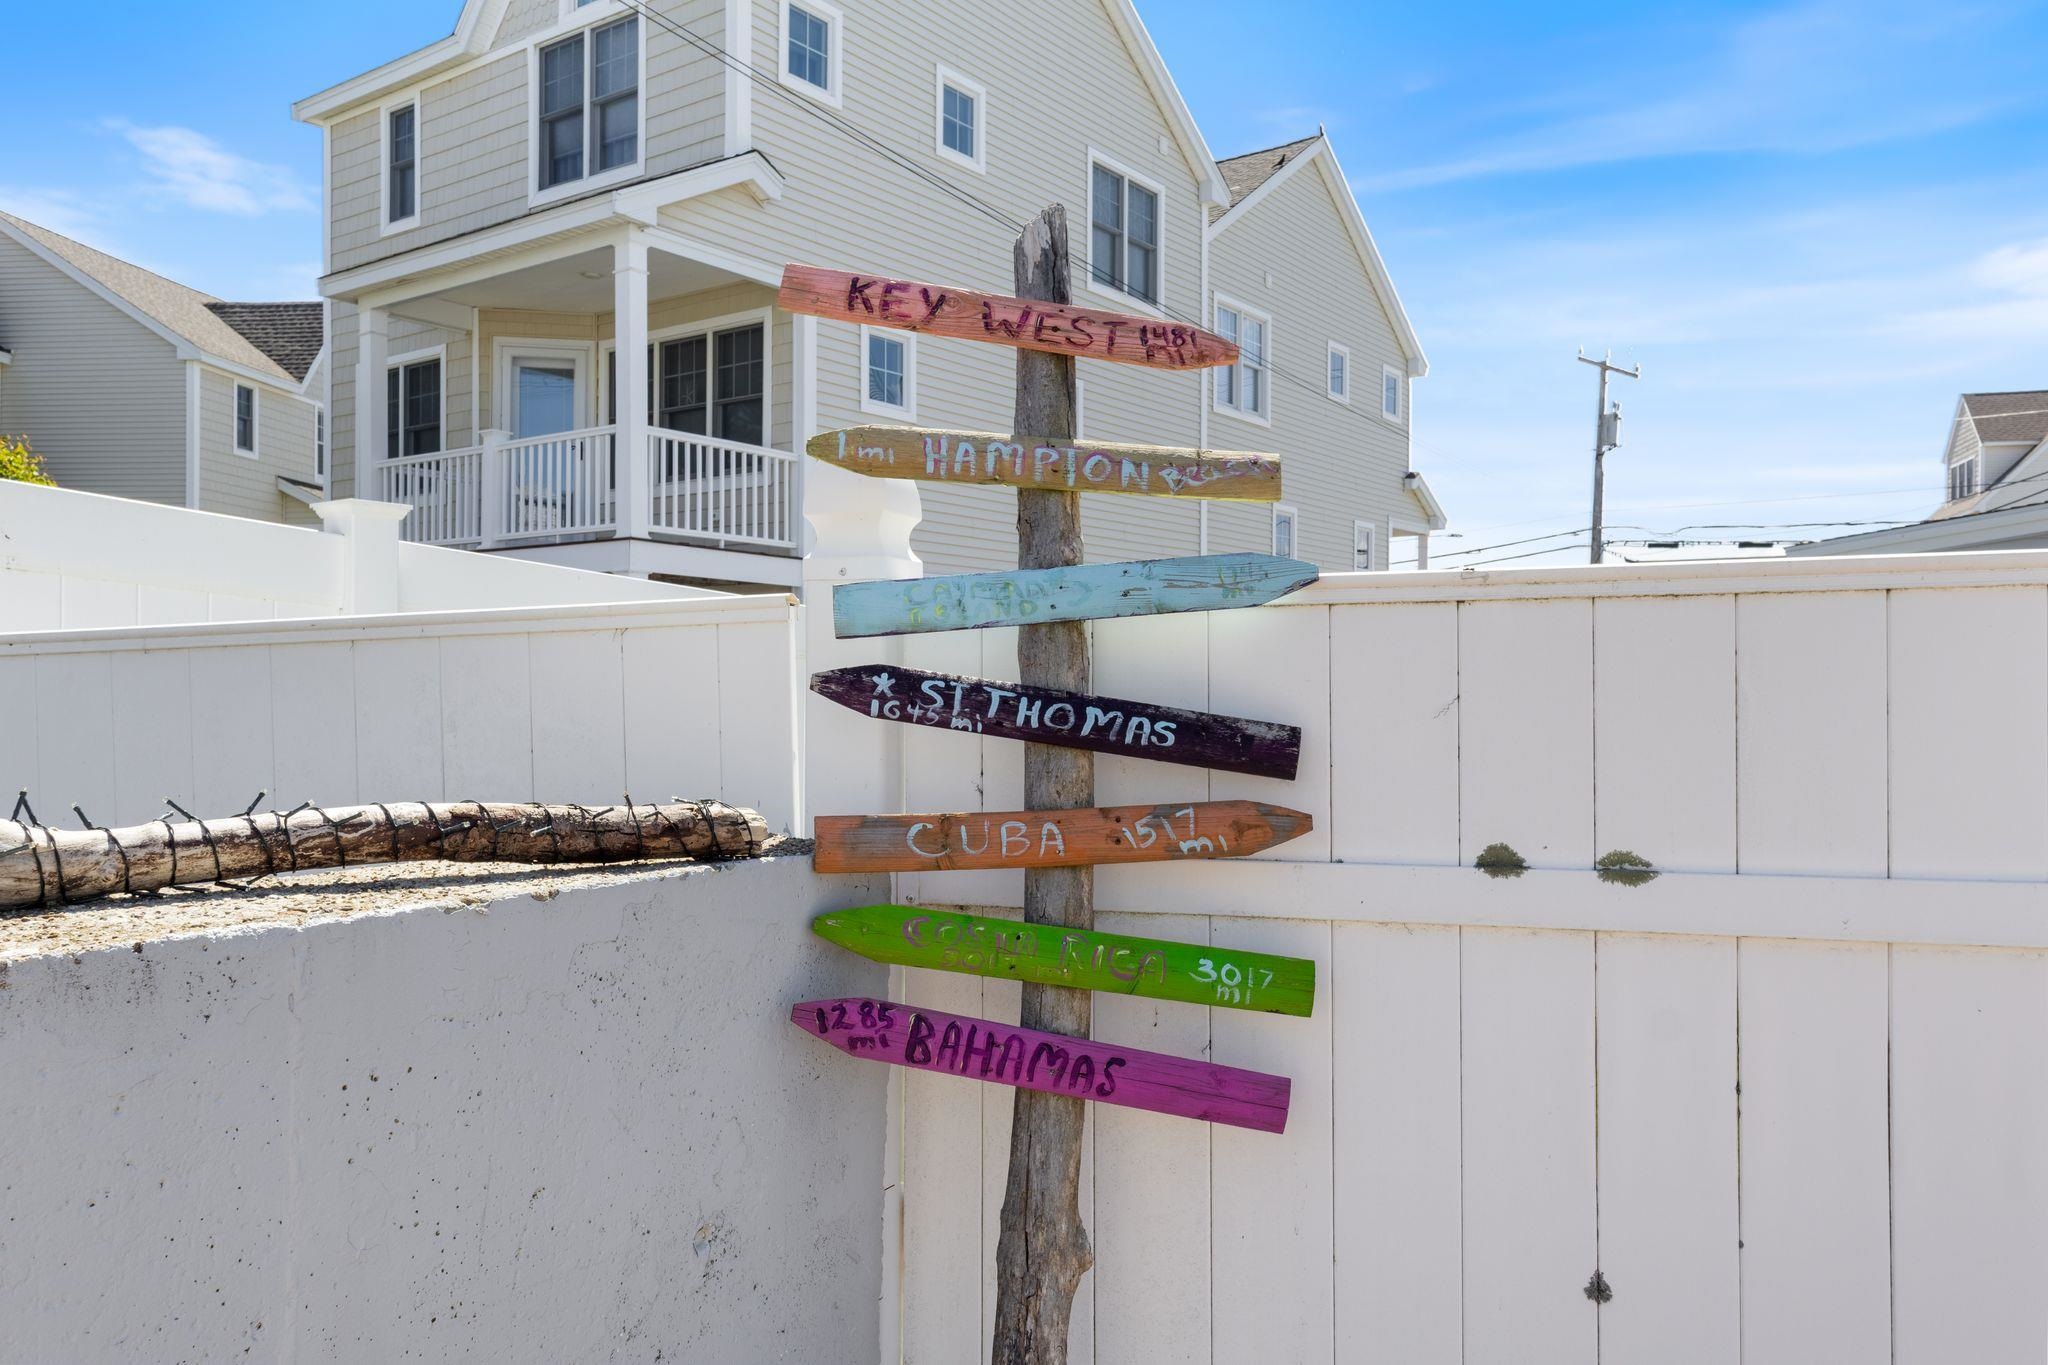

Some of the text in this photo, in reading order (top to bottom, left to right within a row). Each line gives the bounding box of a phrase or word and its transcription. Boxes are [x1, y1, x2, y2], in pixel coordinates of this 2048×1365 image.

[846, 276, 1128, 353] KEY WEST
[1140, 324, 1197, 347] 1481
[857, 446, 894, 463] mi
[923, 435, 1149, 491] HAMPTON
[869, 699, 984, 733] 1645 mi
[906, 807, 1196, 858] CUBA 1517
[1179, 834, 1229, 856] mi
[1190, 958, 1275, 987] 3017
[1216, 985, 1252, 1004] mi
[816, 1003, 896, 1034] 1285
[847, 1012, 1127, 1097] mi BAHAMAS
